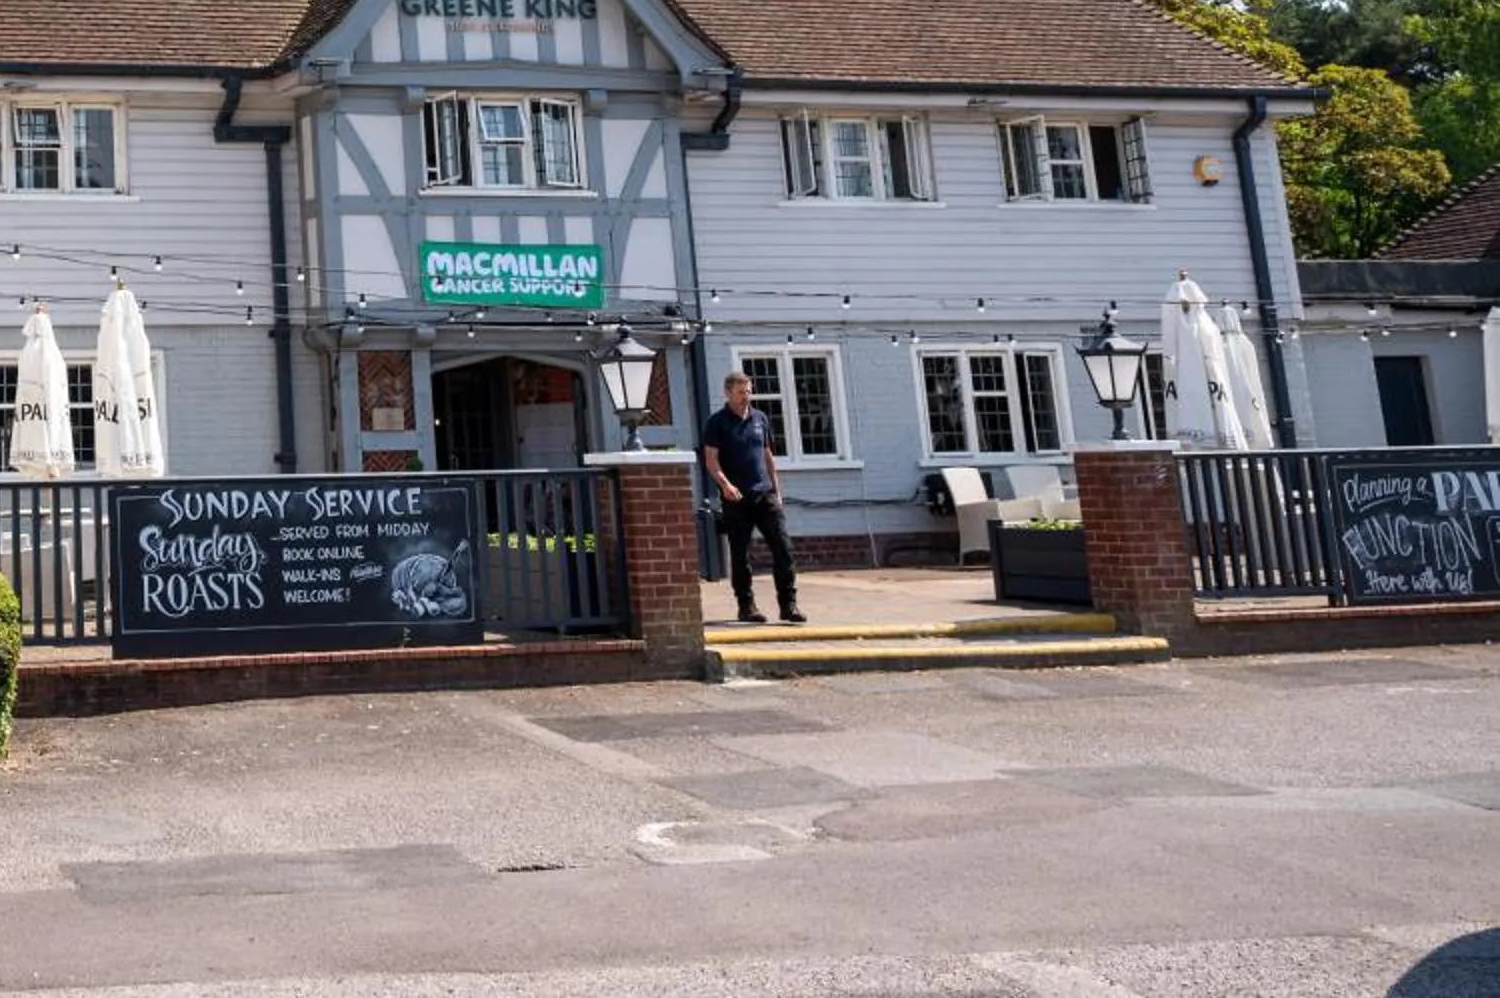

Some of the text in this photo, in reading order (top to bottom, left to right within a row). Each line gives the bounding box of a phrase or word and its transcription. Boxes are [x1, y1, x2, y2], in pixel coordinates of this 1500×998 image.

[426, 251, 598, 278] MACMILLAN
[431, 277, 505, 294] CANCER
[160, 487, 422, 528] SUNDAY SERVICE
[278, 522, 430, 541] SERVED FROM MIDDAY
[1342, 511, 1481, 570] FUNCTION
[139, 525, 268, 572] Sunday
[317, 546, 365, 559] ONLINE
[281, 568, 341, 583] WALK-INS
[141, 571, 265, 618] ROASTS
[283, 588, 350, 603] WELCOME!
